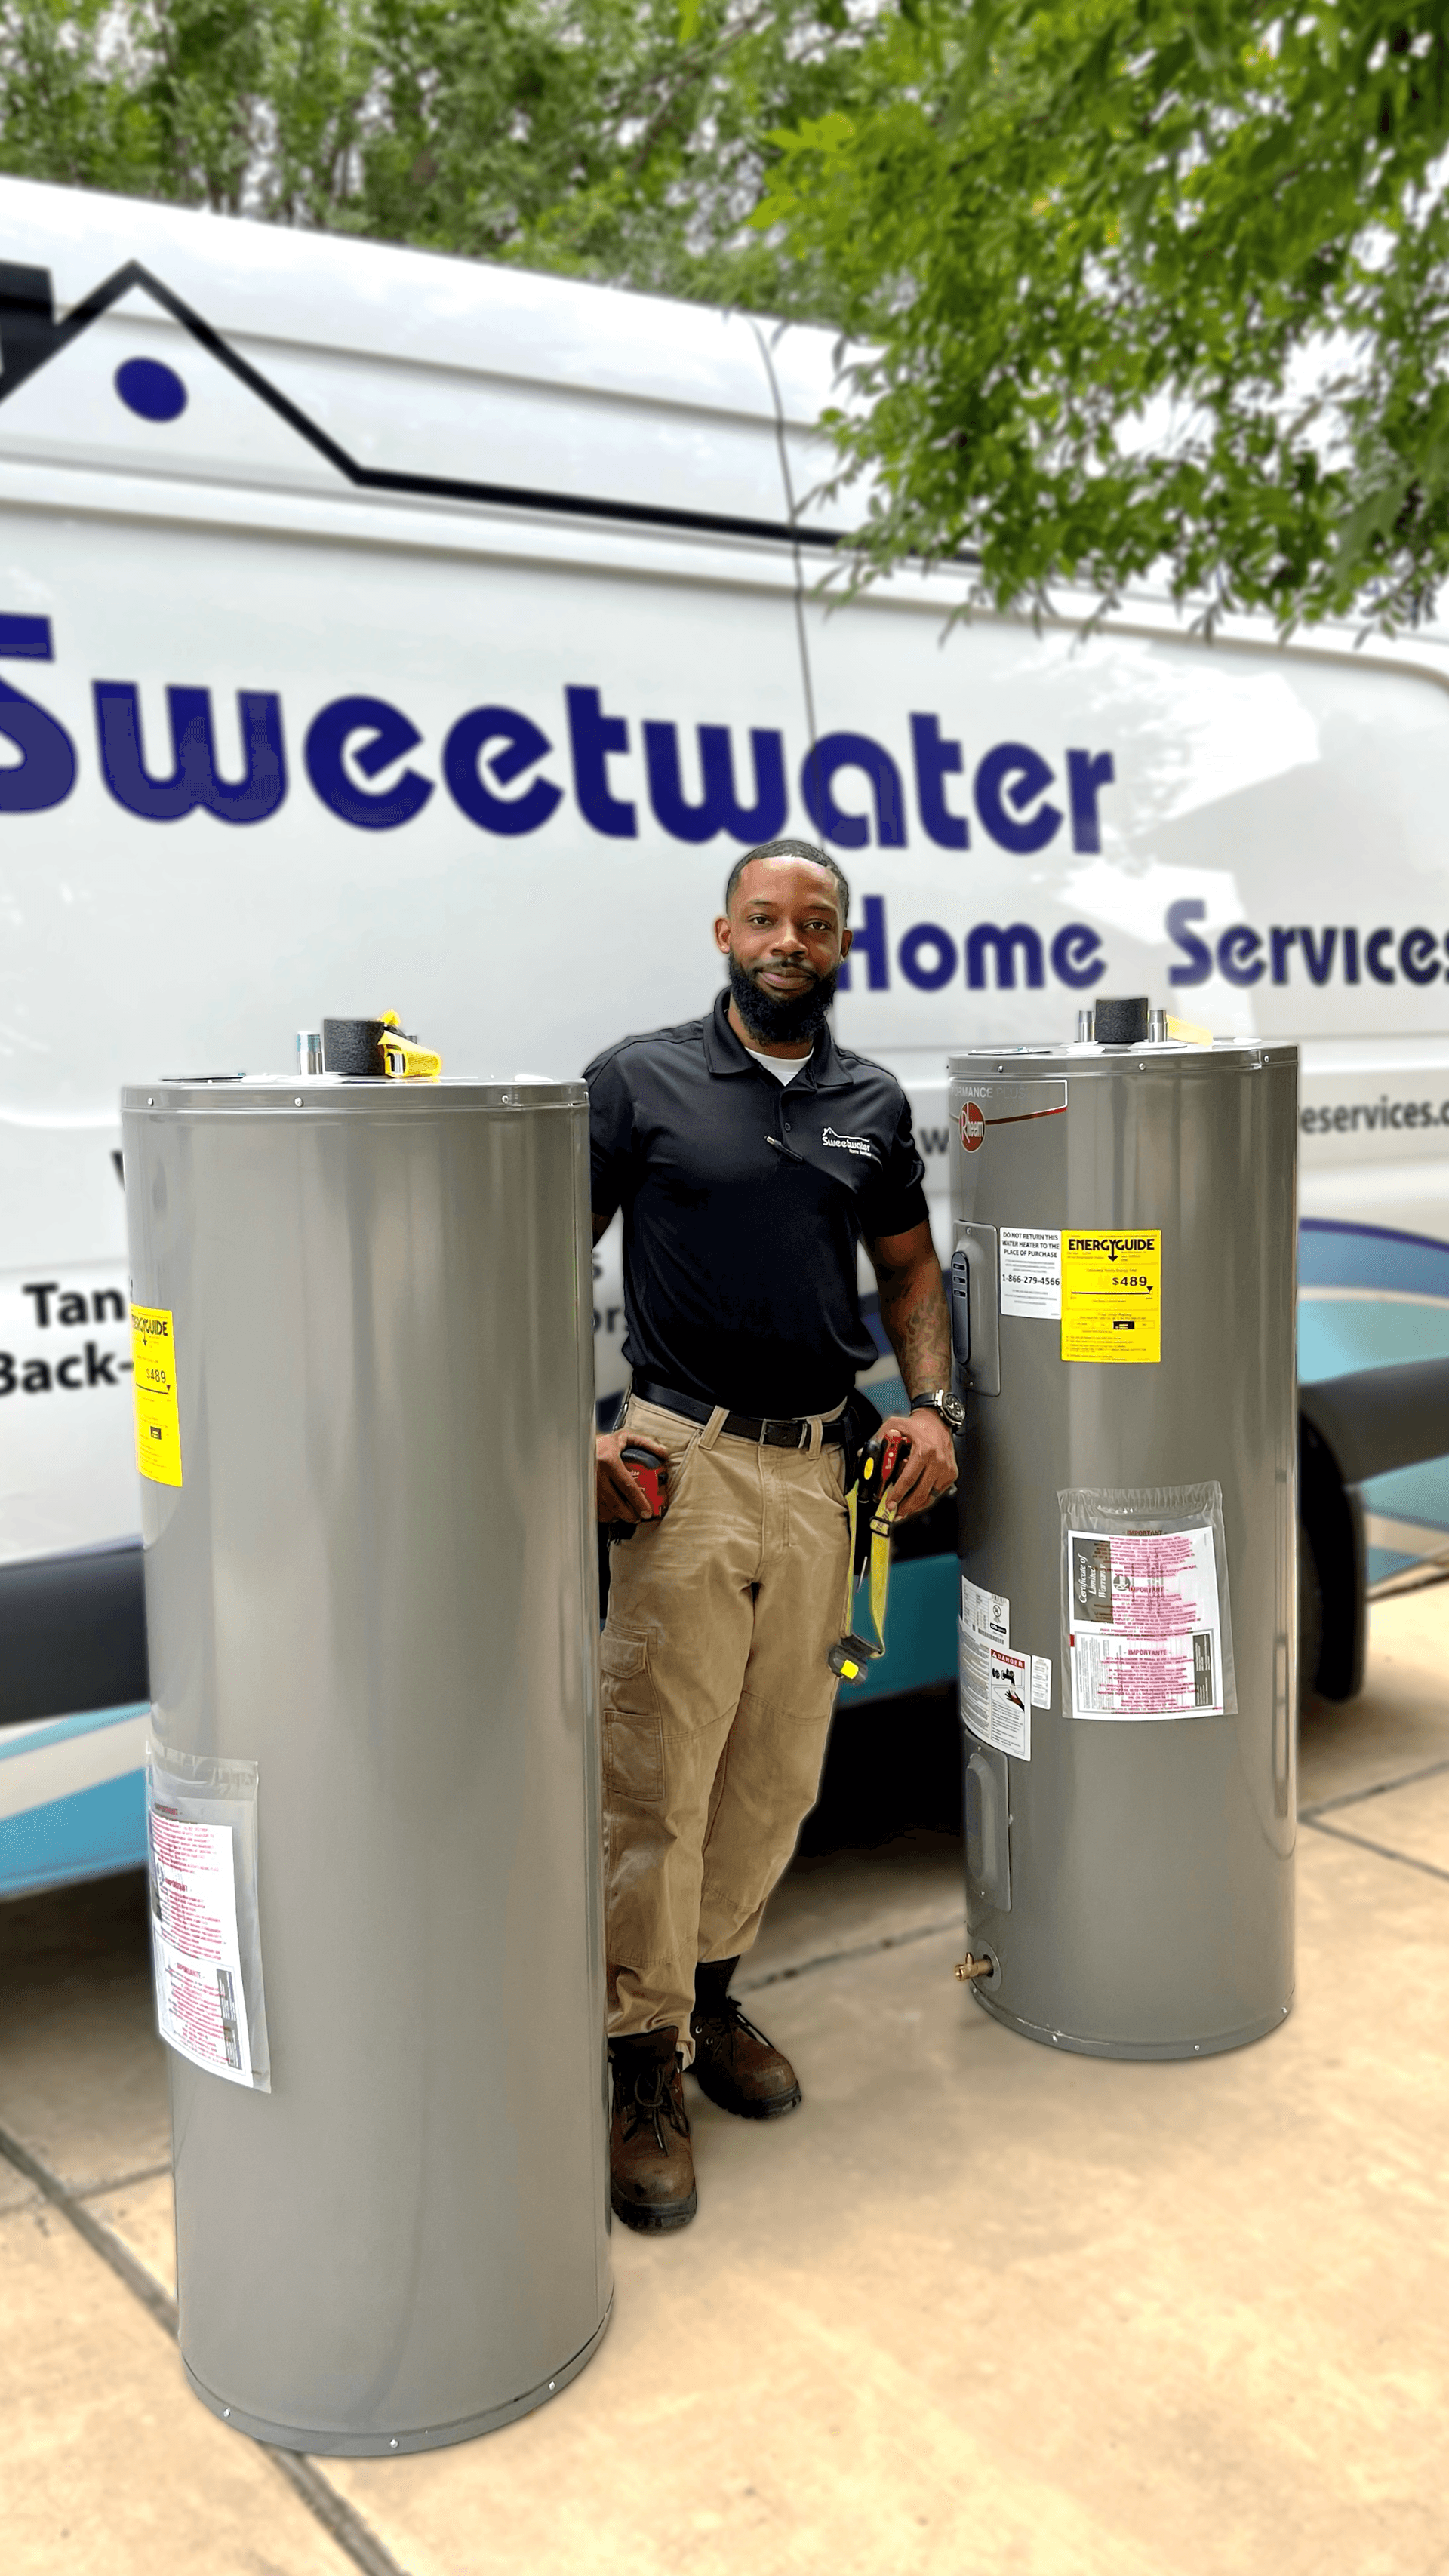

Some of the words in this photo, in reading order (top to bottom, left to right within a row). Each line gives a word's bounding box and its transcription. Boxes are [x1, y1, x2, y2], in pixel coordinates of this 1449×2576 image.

[0, 613, 1115, 856] Sweetwater
[837, 895, 1106, 992] Home
[1166, 899, 1449, 987] Service
[822, 1136, 871, 1152] Sweetwater
[1068, 1238, 1155, 1251] ENERGYGUIDE
[1002, 1274, 1060, 1286] 1-866-279-4566
[998, 1654, 1023, 1668] DANGER
